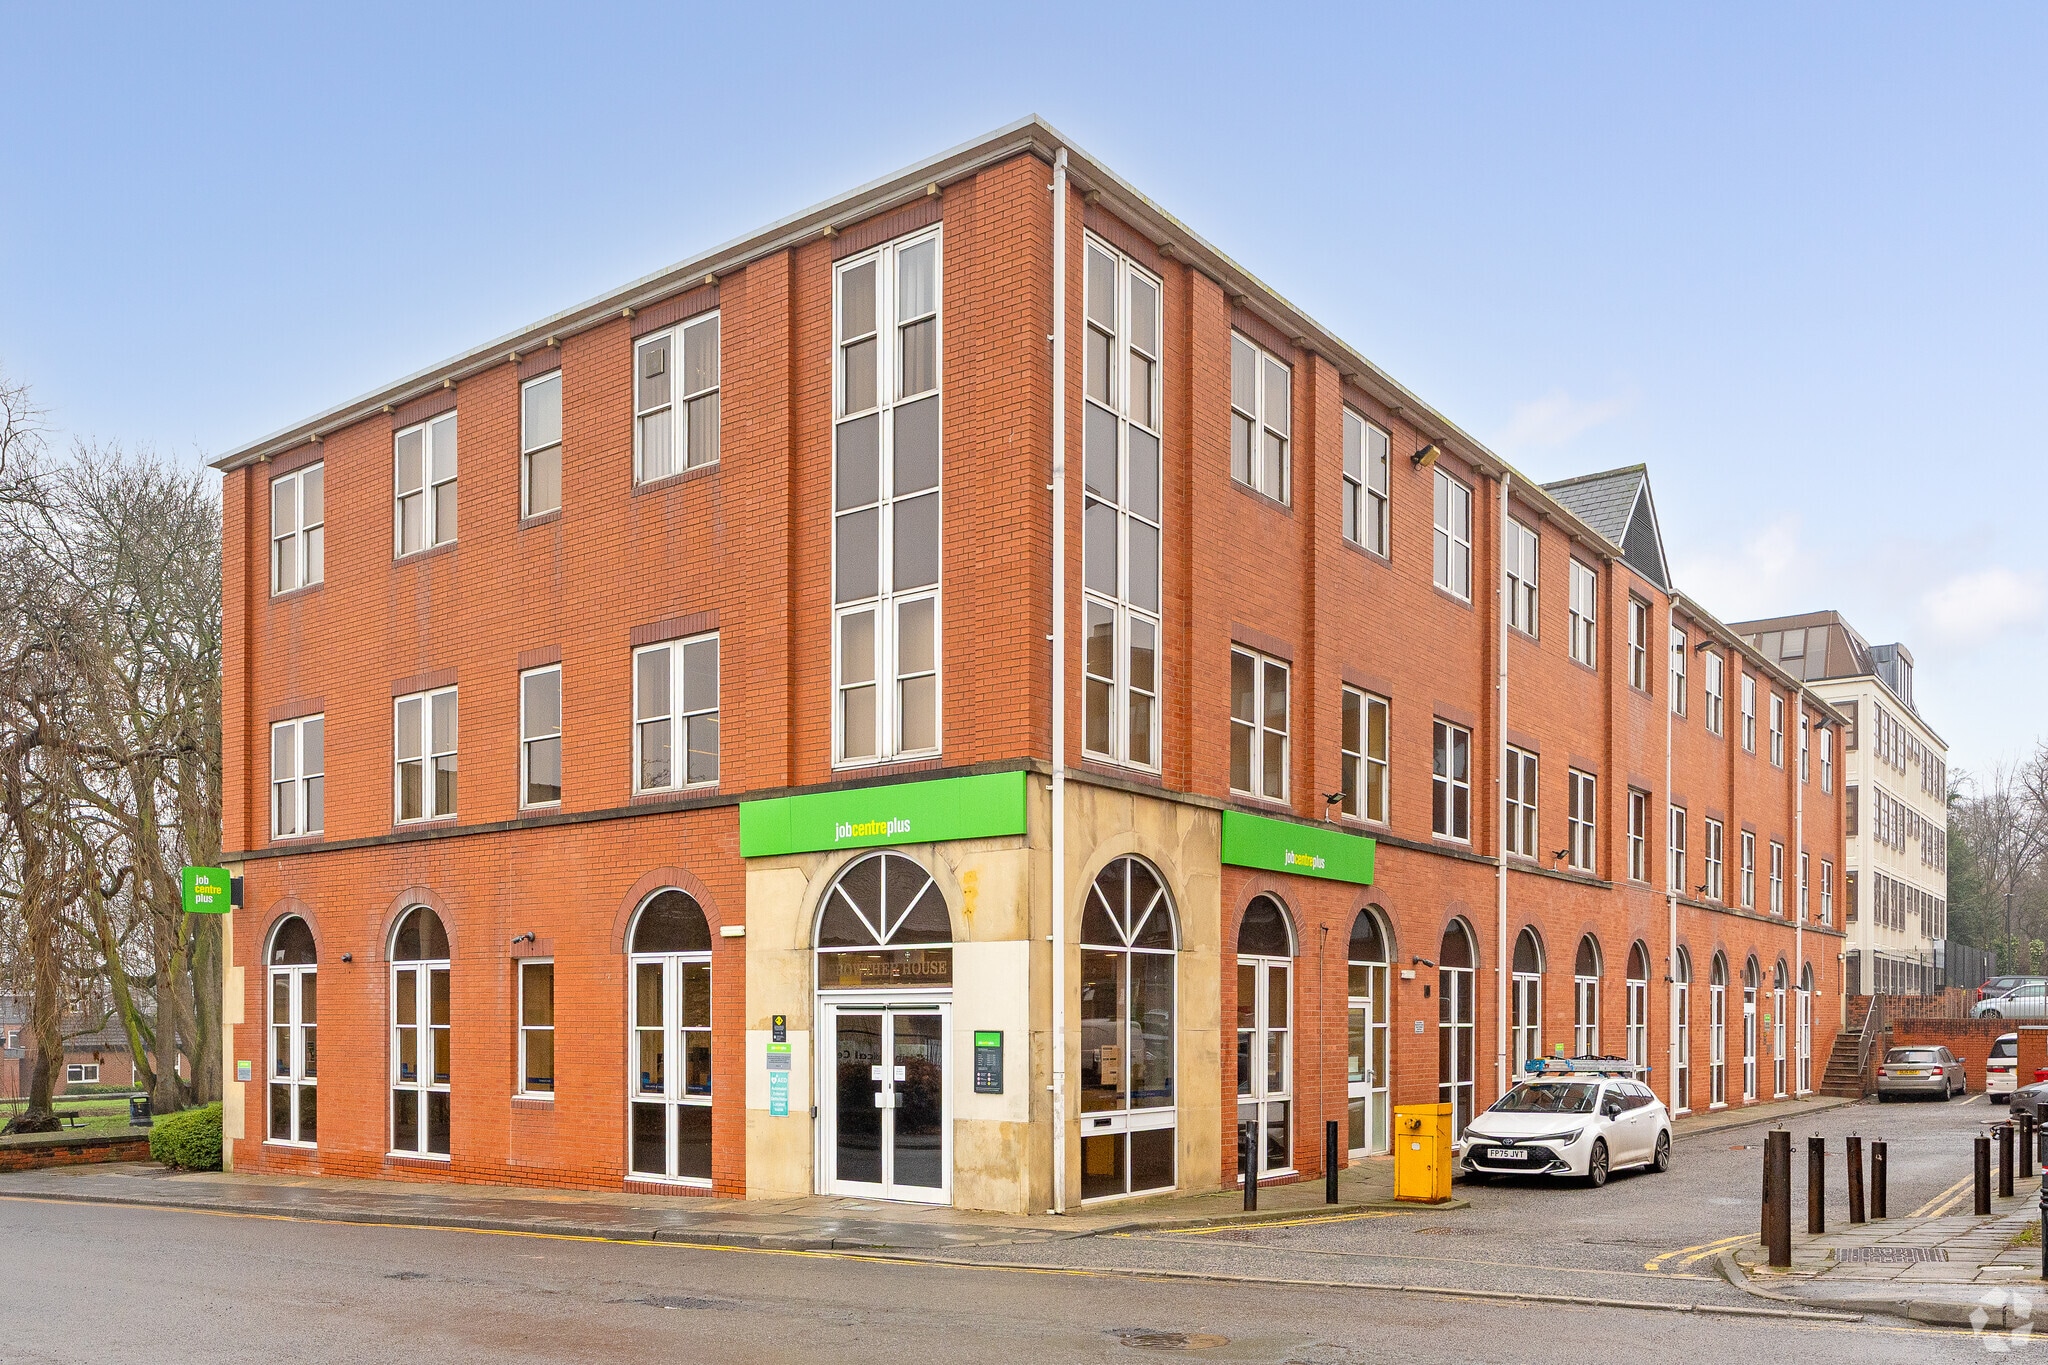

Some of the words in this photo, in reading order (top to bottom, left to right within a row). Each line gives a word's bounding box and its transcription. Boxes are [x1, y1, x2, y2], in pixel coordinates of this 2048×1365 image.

[834, 816, 911, 842] jobcentreplus
[1284, 849, 1326, 870] jobcentreplus
[195, 874, 209, 886] job
[194, 885, 222, 895] centre
[195, 894, 214, 905] plus
[902, 960, 947, 976] HOUSE
[1490, 1150, 1509, 1158] FP75
